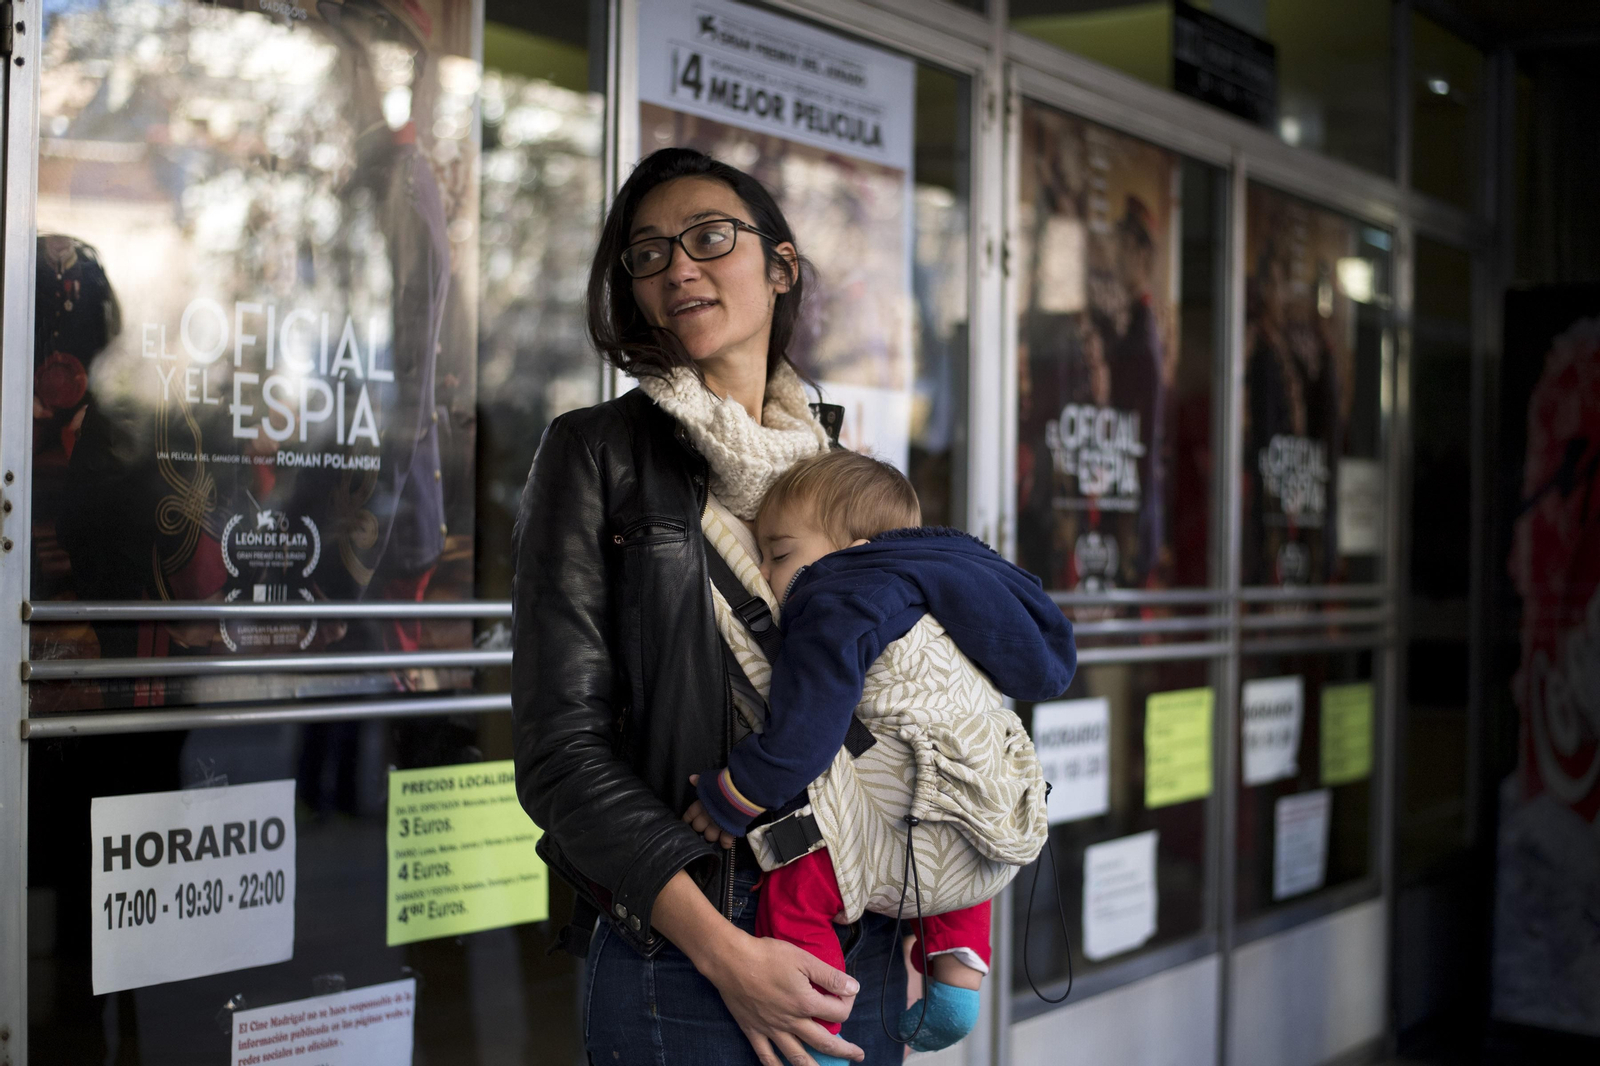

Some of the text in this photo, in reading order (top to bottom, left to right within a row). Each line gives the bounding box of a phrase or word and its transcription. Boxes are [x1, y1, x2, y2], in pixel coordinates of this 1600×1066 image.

[680, 52, 704, 101] 4
[708, 77, 785, 124] MEJOR
[141, 298, 395, 382] EL OFICIAL
[155, 365, 381, 447] Y EL ESPÍA
[277, 451, 321, 467] ROMAN
[323, 453, 381, 471] POLANSKI
[235, 529, 308, 547] LEÓN DE PLATA
[402, 777, 455, 795] PRECIOS
[399, 817, 455, 837] 3 Euros.
[103, 816, 286, 872] HORARIO
[397, 861, 455, 881] 4 Euros.
[104, 888, 157, 930] 17:00
[175, 878, 223, 919] 19:30
[238, 869, 285, 910] 22:00
[238, 1022, 248, 1034] El
[250, 1019, 269, 1032] Cine
[270, 1010, 306, 1028] Madrigal
[307, 1010, 318, 1021] no
[319, 1010, 328, 1019] se
[329, 1004, 347, 1017] hace
[238, 1033, 288, 1051] información
[290, 1024, 330, 1043] publicada
[238, 1054, 260, 1066] redes
[263, 1047, 293, 1063] sociales
[295, 1043, 306, 1055] no
